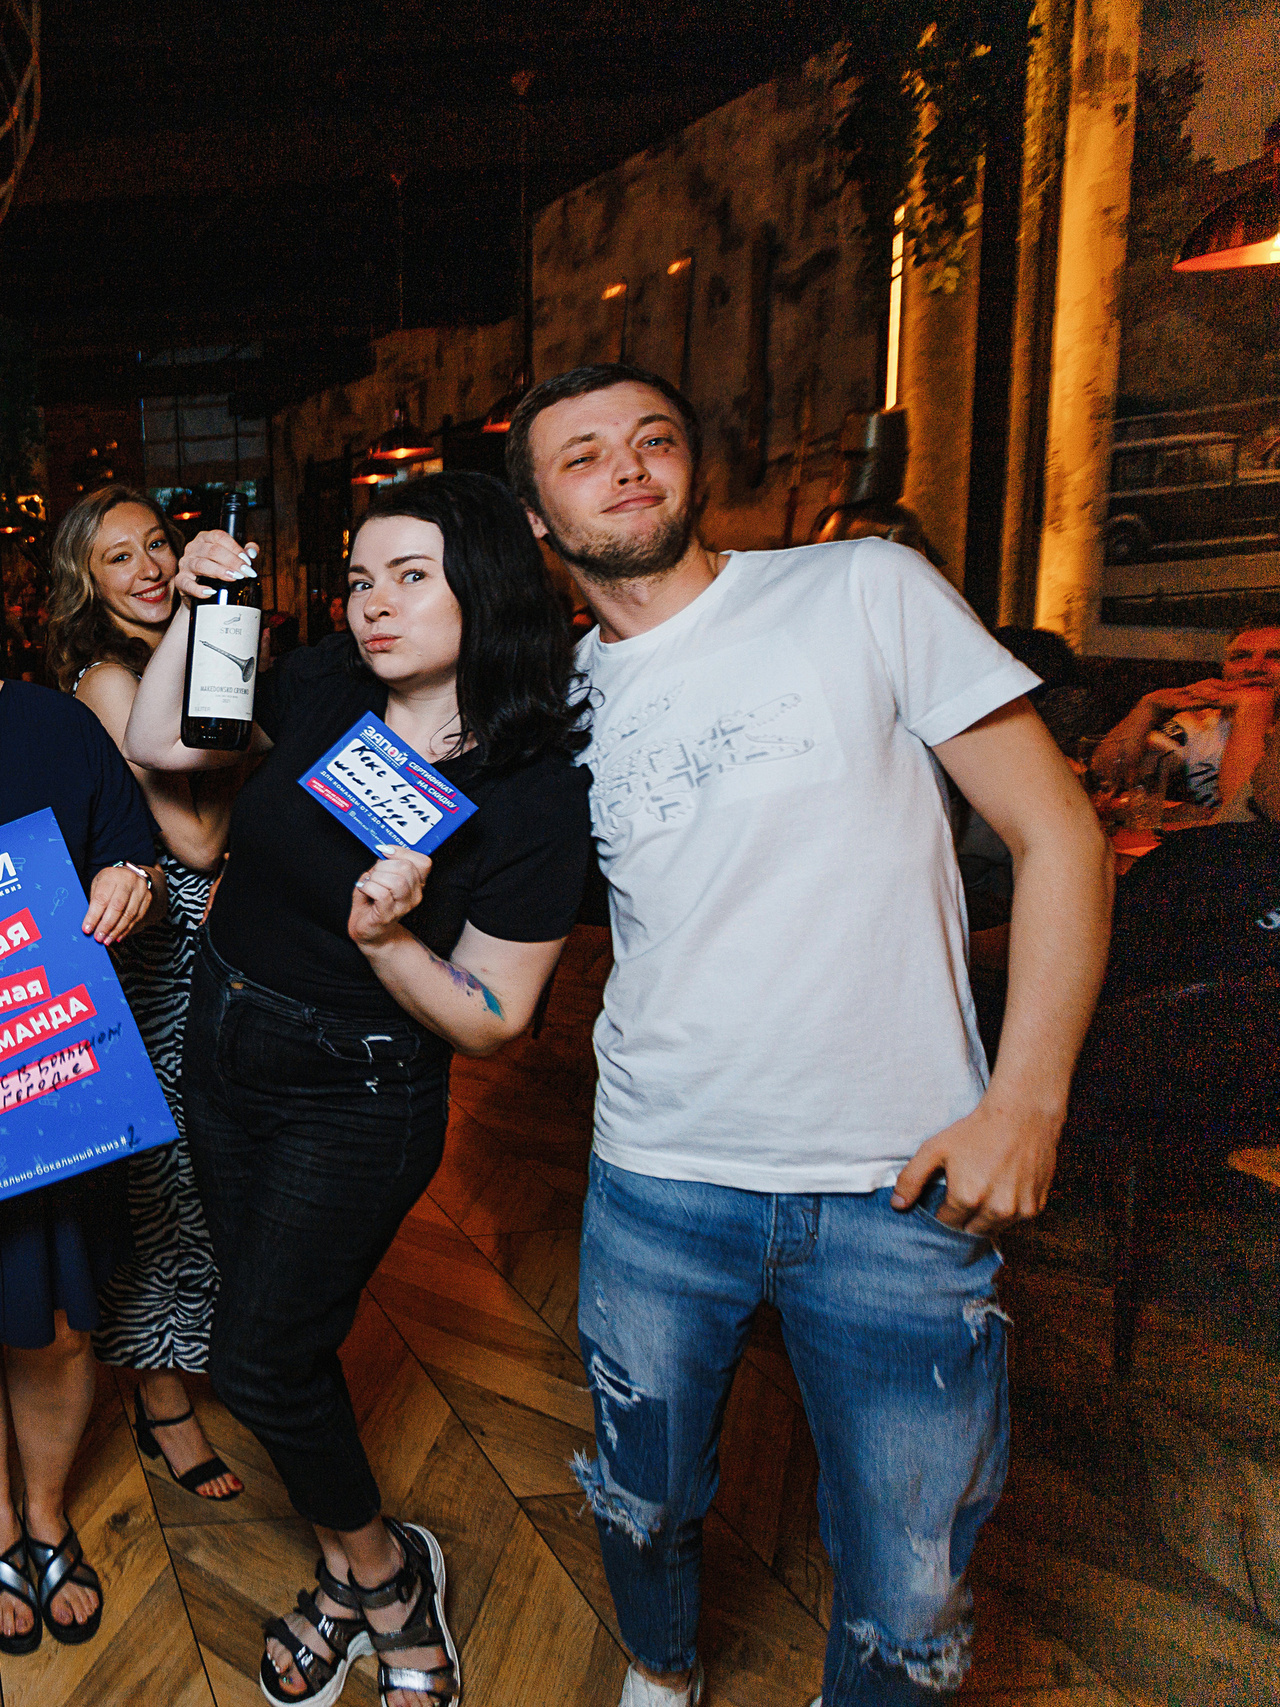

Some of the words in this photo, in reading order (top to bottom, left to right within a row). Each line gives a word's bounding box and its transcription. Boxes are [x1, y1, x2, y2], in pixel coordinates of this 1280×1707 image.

[220, 627, 242, 635] STOBI
[364, 725, 408, 766] ЗАПОЙ
[408, 761, 455, 794] СЕРТИФИКАТ
[333, 781, 361, 806] КОМАНДЫ
[360, 806, 369, 814] ОТ
[417, 780, 428, 789] НА
[427, 786, 458, 808] СКИДКУ
[95, 1140, 120, 1156] квиз
